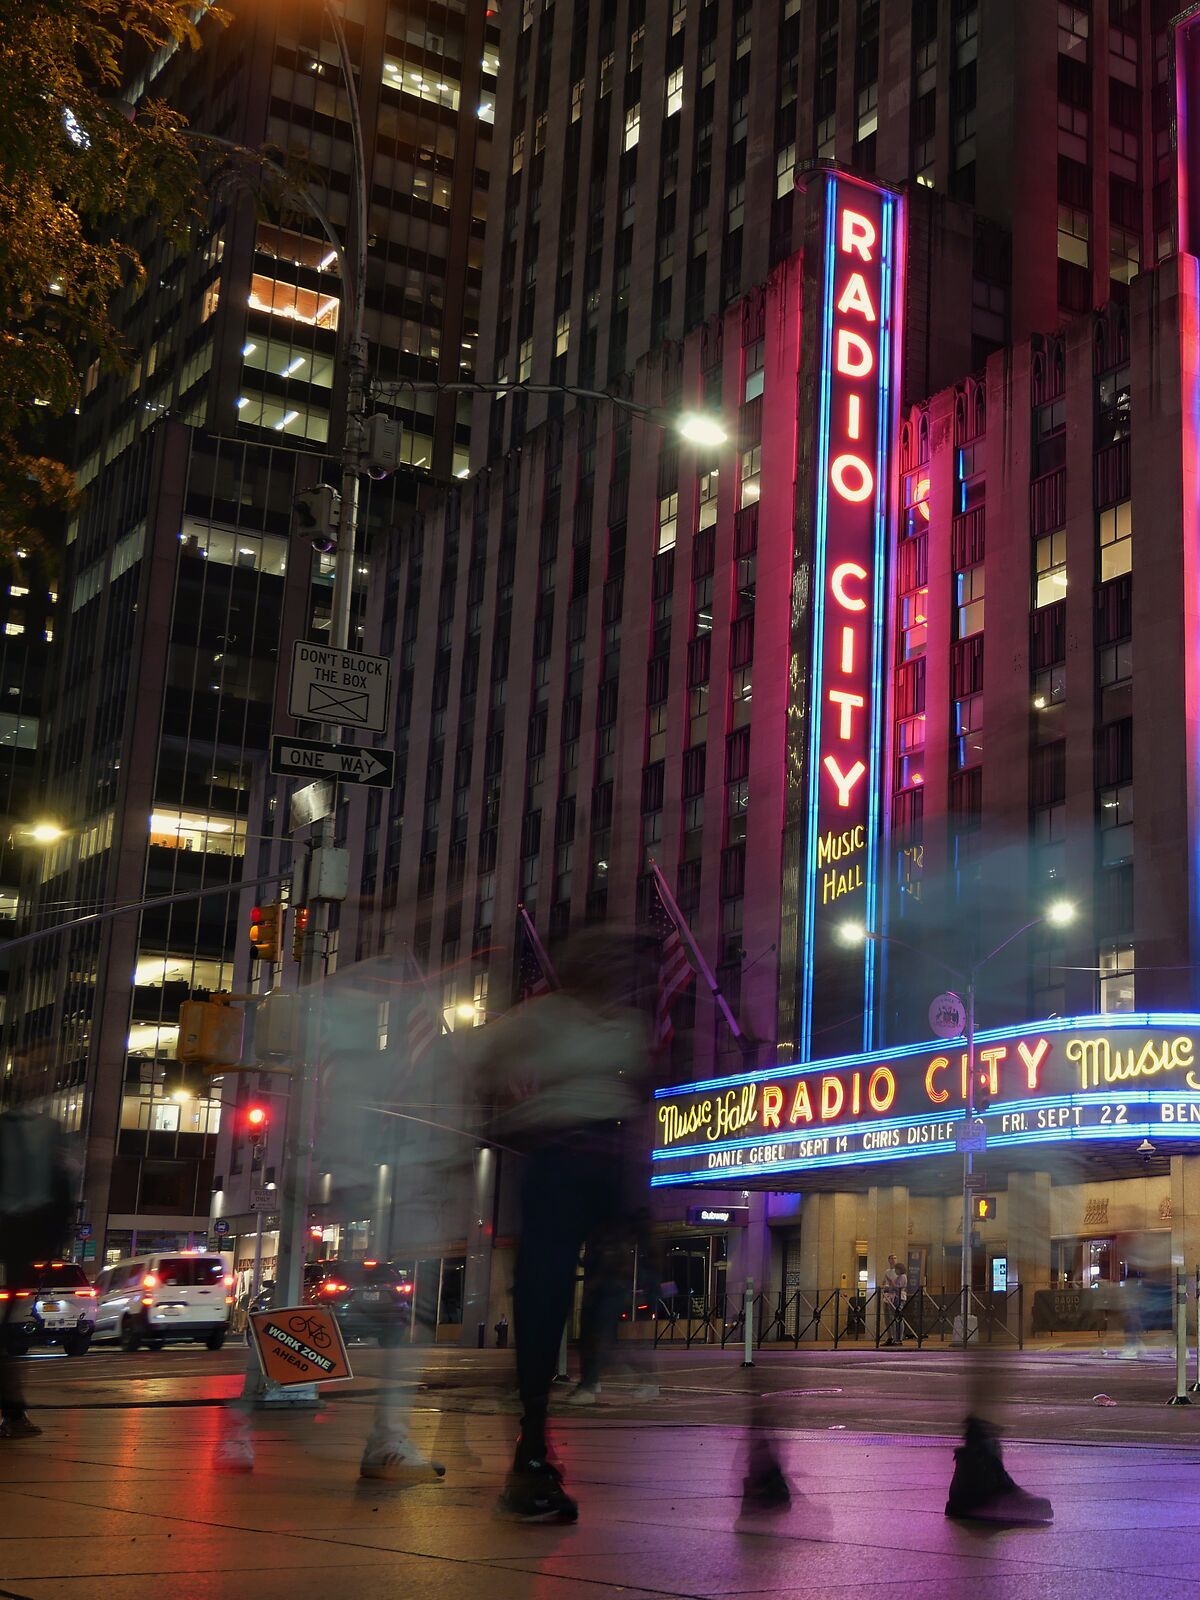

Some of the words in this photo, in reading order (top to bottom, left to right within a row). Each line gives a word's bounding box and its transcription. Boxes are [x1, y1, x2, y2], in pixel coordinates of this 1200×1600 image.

[831, 208, 876, 503] RADIO
[300, 648, 338, 667] DON'T
[341, 656, 383, 676] BLOCK
[314, 667, 338, 684] THE
[343, 673, 367, 689] BOX
[824, 562, 868, 808] CITY
[290, 750, 325, 768] ONE
[340, 756, 376, 774] WAY
[817, 823, 866, 869] MUSIC
[822, 863, 865, 905] HALL
[762, 1066, 897, 1128] RADIO
[925, 1038, 1051, 1104] CITY
[706, 1083, 758, 1141] Hall
[708, 1149, 743, 1169] DANTE
[749, 1144, 785, 1164] GEBEL
[799, 1137, 829, 1158] SEPT
[836, 1136, 848, 1153] 14
[863, 1123, 900, 1151] CHRIS
[1002, 1113, 1028, 1133] FRI.
[1037, 1107, 1083, 1129] SEPT
[1101, 1103, 1128, 1126] 22
[701, 1210, 730, 1222] Subway
[1055, 1295, 1080, 1305] RADIO
[1055, 1304, 1080, 1312] CITY
[267, 1326, 302, 1351] WORK
[301, 1346, 332, 1370] ZONE
[272, 1347, 309, 1372] AHEAD
